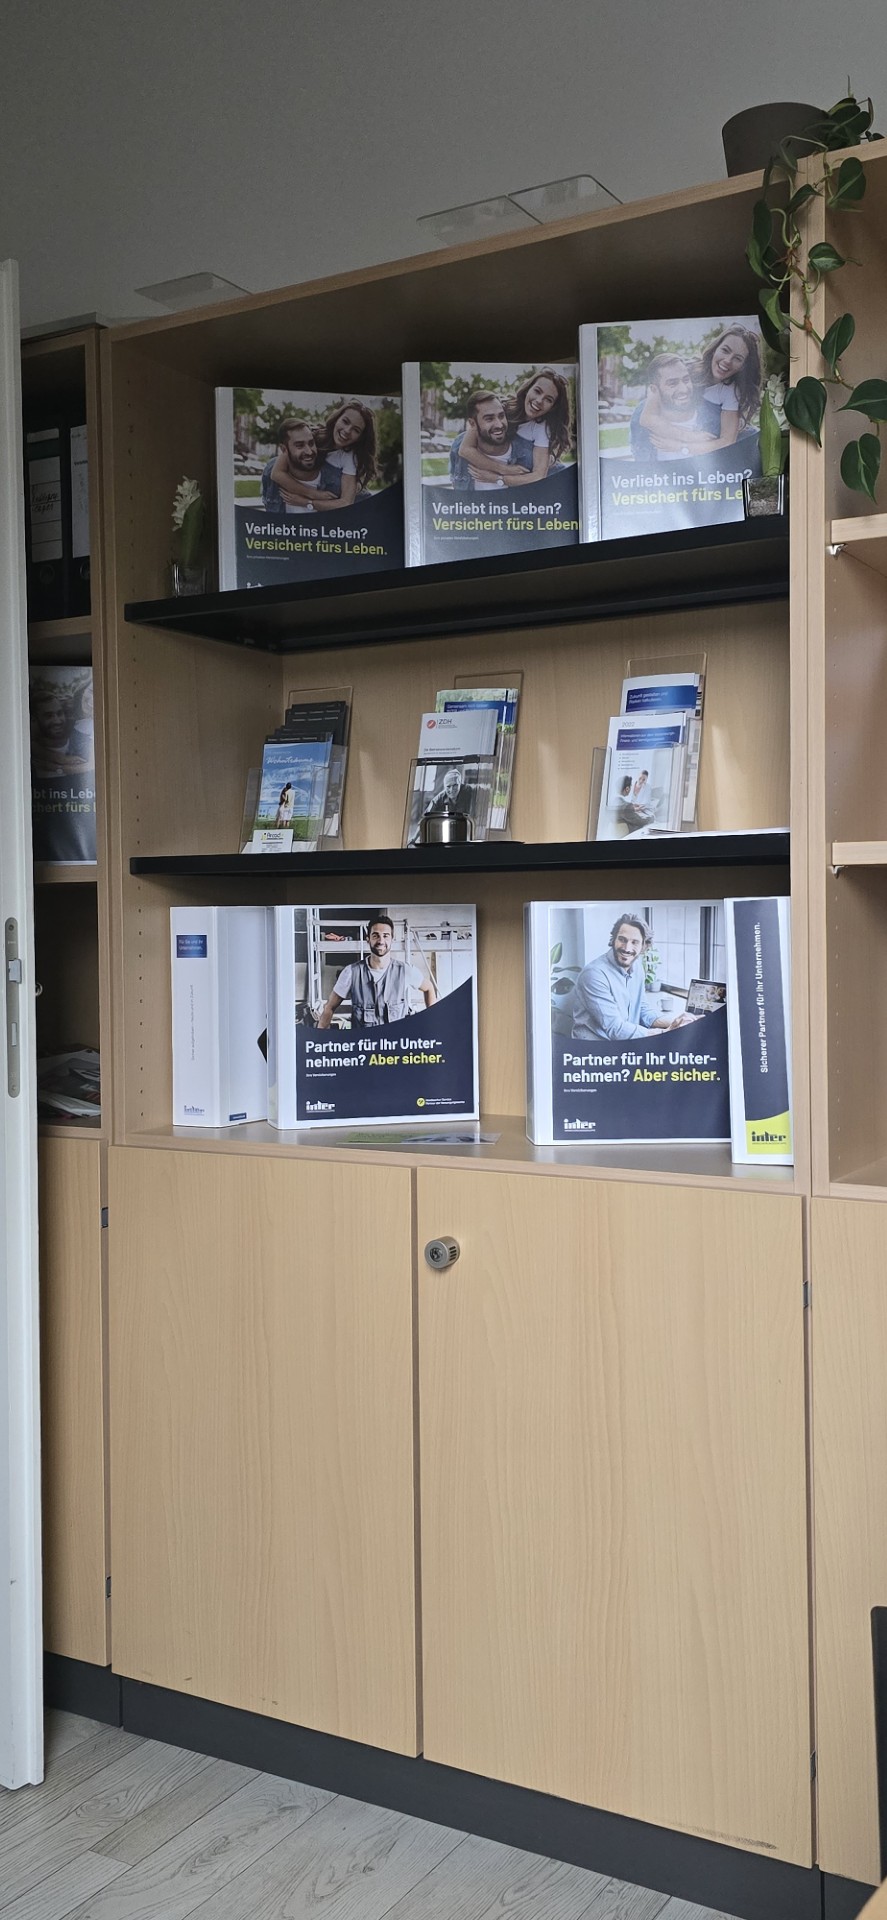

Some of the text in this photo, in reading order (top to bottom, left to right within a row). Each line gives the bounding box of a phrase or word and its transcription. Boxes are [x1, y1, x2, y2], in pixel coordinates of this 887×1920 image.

[611, 469, 752, 489] Verliebt ins Leben?
[612, 491, 688, 506] Versichert
[692, 488, 721, 502] fürs
[432, 502, 562, 515] Verliebt ins Leben?
[245, 522, 368, 539] Verliebt ins Leben?
[432, 517, 503, 531] Versichert
[506, 518, 533, 530] fürs
[245, 537, 388, 555] Versichert fürs Leben.
[49, 788, 67, 799] ins
[65, 802, 91, 812] fürs
[754, 922, 769, 1073] Sicherer Partner für Ihr Unternehmen.
[305, 1037, 442, 1053] Partner für Ihr Unter-
[305, 1052, 445, 1068] nehmen? Aber sicher.
[563, 1051, 717, 1066] Partner für Ihr Unter-
[563, 1068, 721, 1083] nehmen? Aber sicher.
[306, 1101, 335, 1110] inter
[563, 1118, 596, 1130] inter
[751, 1131, 786, 1142] inter
